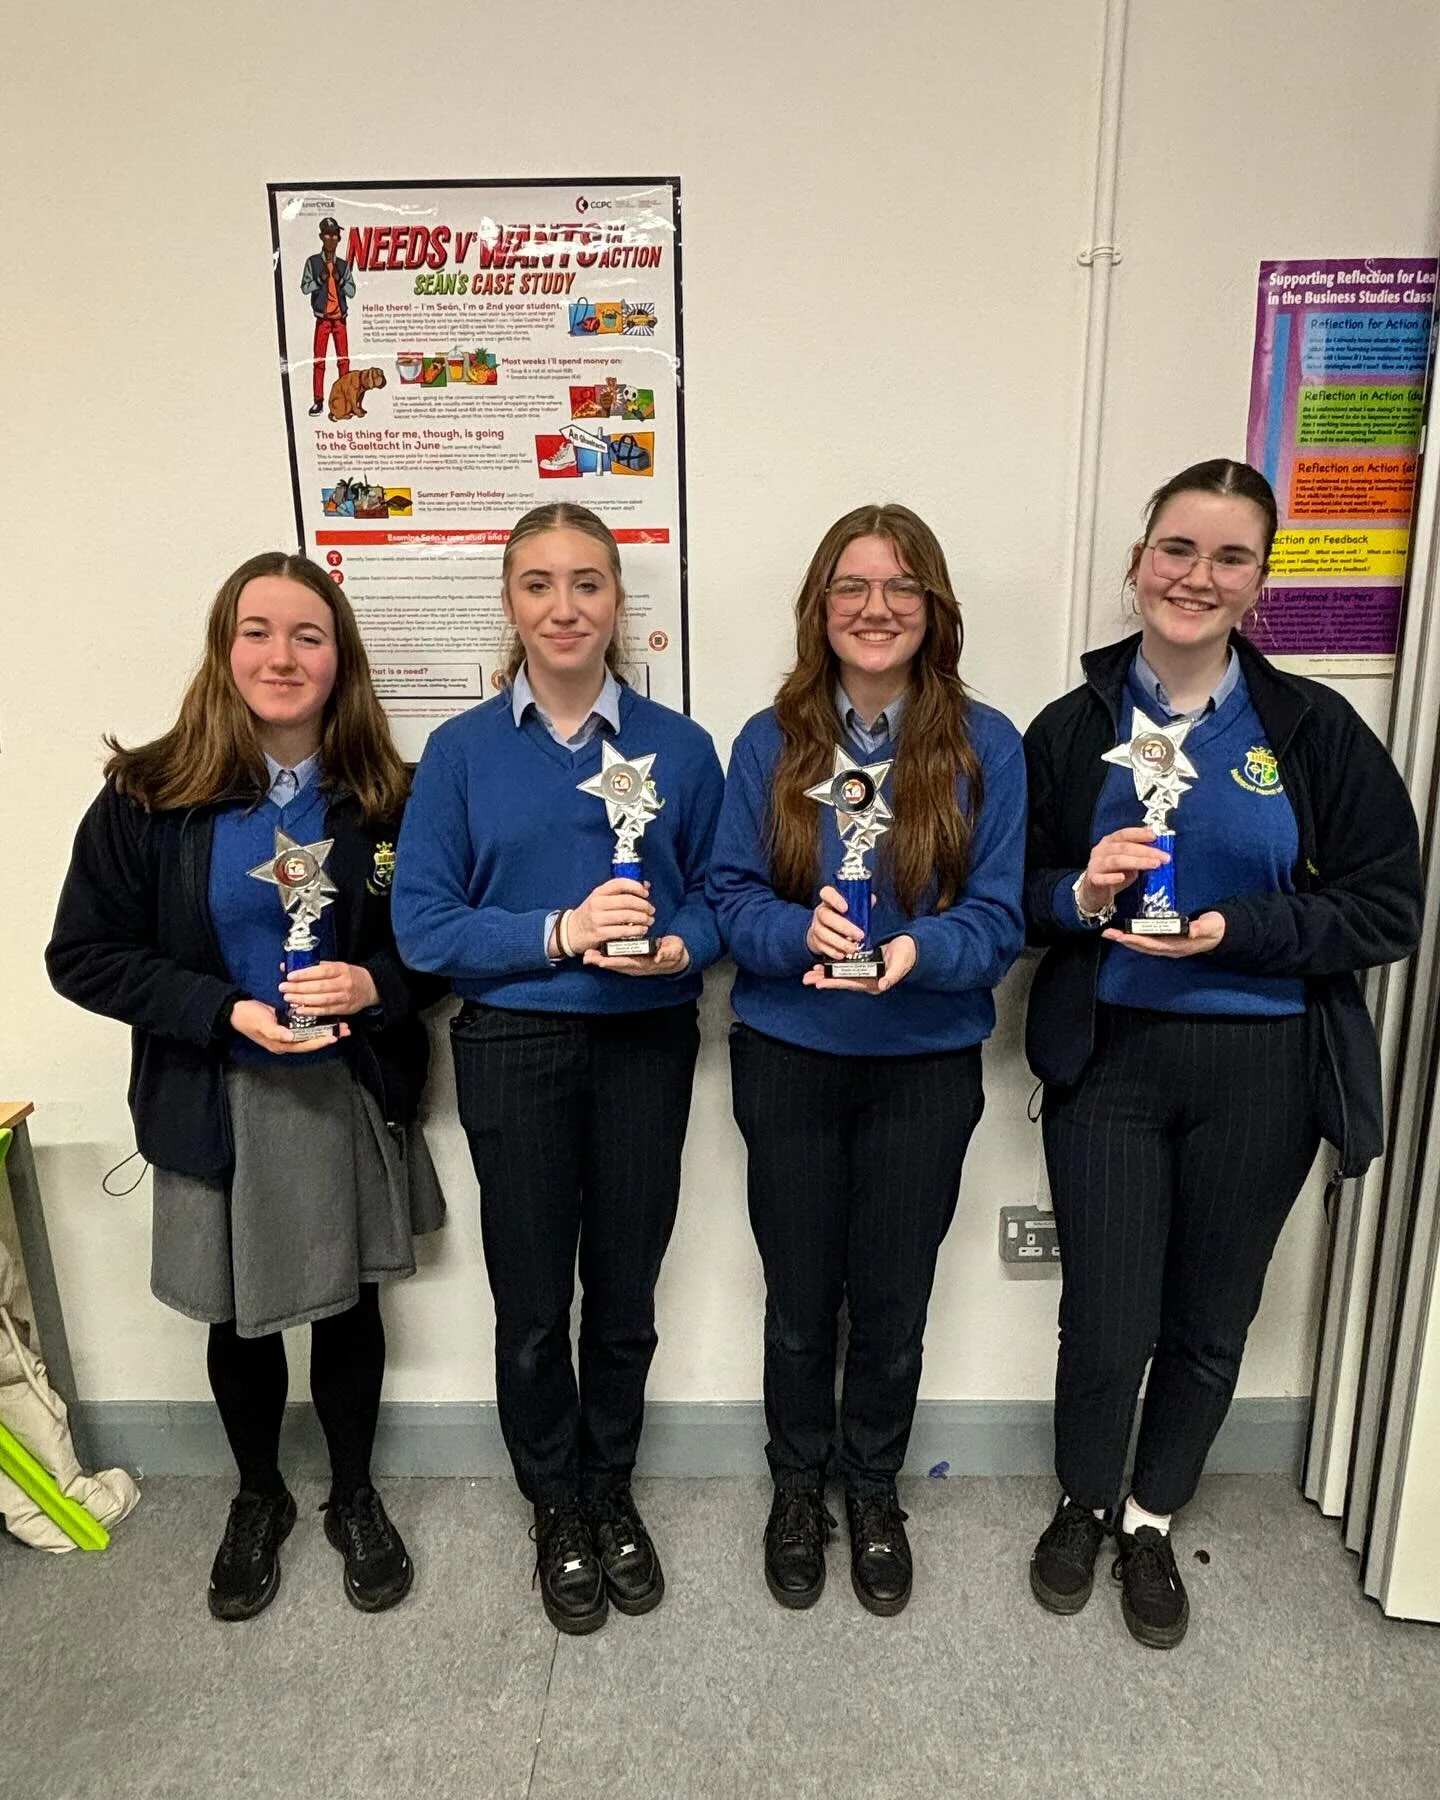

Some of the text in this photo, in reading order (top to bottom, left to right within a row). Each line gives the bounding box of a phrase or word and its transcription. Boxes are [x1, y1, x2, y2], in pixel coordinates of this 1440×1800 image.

[346, 225, 451, 272] NEEDS
[599, 246, 662, 269] ACTION
[413, 269, 577, 296] SEÁN'S CASE STUDY
[1269, 271, 1334, 289] Supporting
[1337, 269, 1394, 285] Reflection
[1396, 269, 1414, 284] for
[1268, 292, 1280, 305] in
[1282, 290, 1302, 304] the
[1304, 290, 1356, 304] Business
[1358, 289, 1400, 304] Studies
[362, 304, 385, 312] Hello
[386, 304, 412, 312] there!
[437, 302, 462, 312] Seán,
[463, 302, 476, 310] I'm
[486, 302, 504, 310] 2nd
[505, 304, 524, 312] year
[526, 302, 562, 310] student.
[1310, 319, 1364, 330] Reflection
[1368, 318, 1384, 330] for
[1386, 318, 1418, 330] Action
[502, 358, 520, 366] Most
[559, 358, 582, 366] spend
[583, 358, 608, 366] money
[1305, 391, 1355, 400] Reflection
[1360, 391, 1368, 400] in
[1372, 391, 1403, 400] Action
[314, 429, 504, 442] The big thing for me, though, is going
[316, 442, 328, 450] to
[330, 442, 347, 450] the
[349, 441, 401, 450] Gaeltacht
[402, 441, 412, 450] in
[414, 440, 442, 450] June
[1298, 463, 1348, 472] Reflection
[1367, 463, 1399, 472] Action
[450, 490, 476, 499] Family
[477, 490, 505, 499] Holiday
[1273, 536, 1304, 544] ection
[1324, 535, 1368, 544] Feedback
[370, 668, 386, 676] hat
